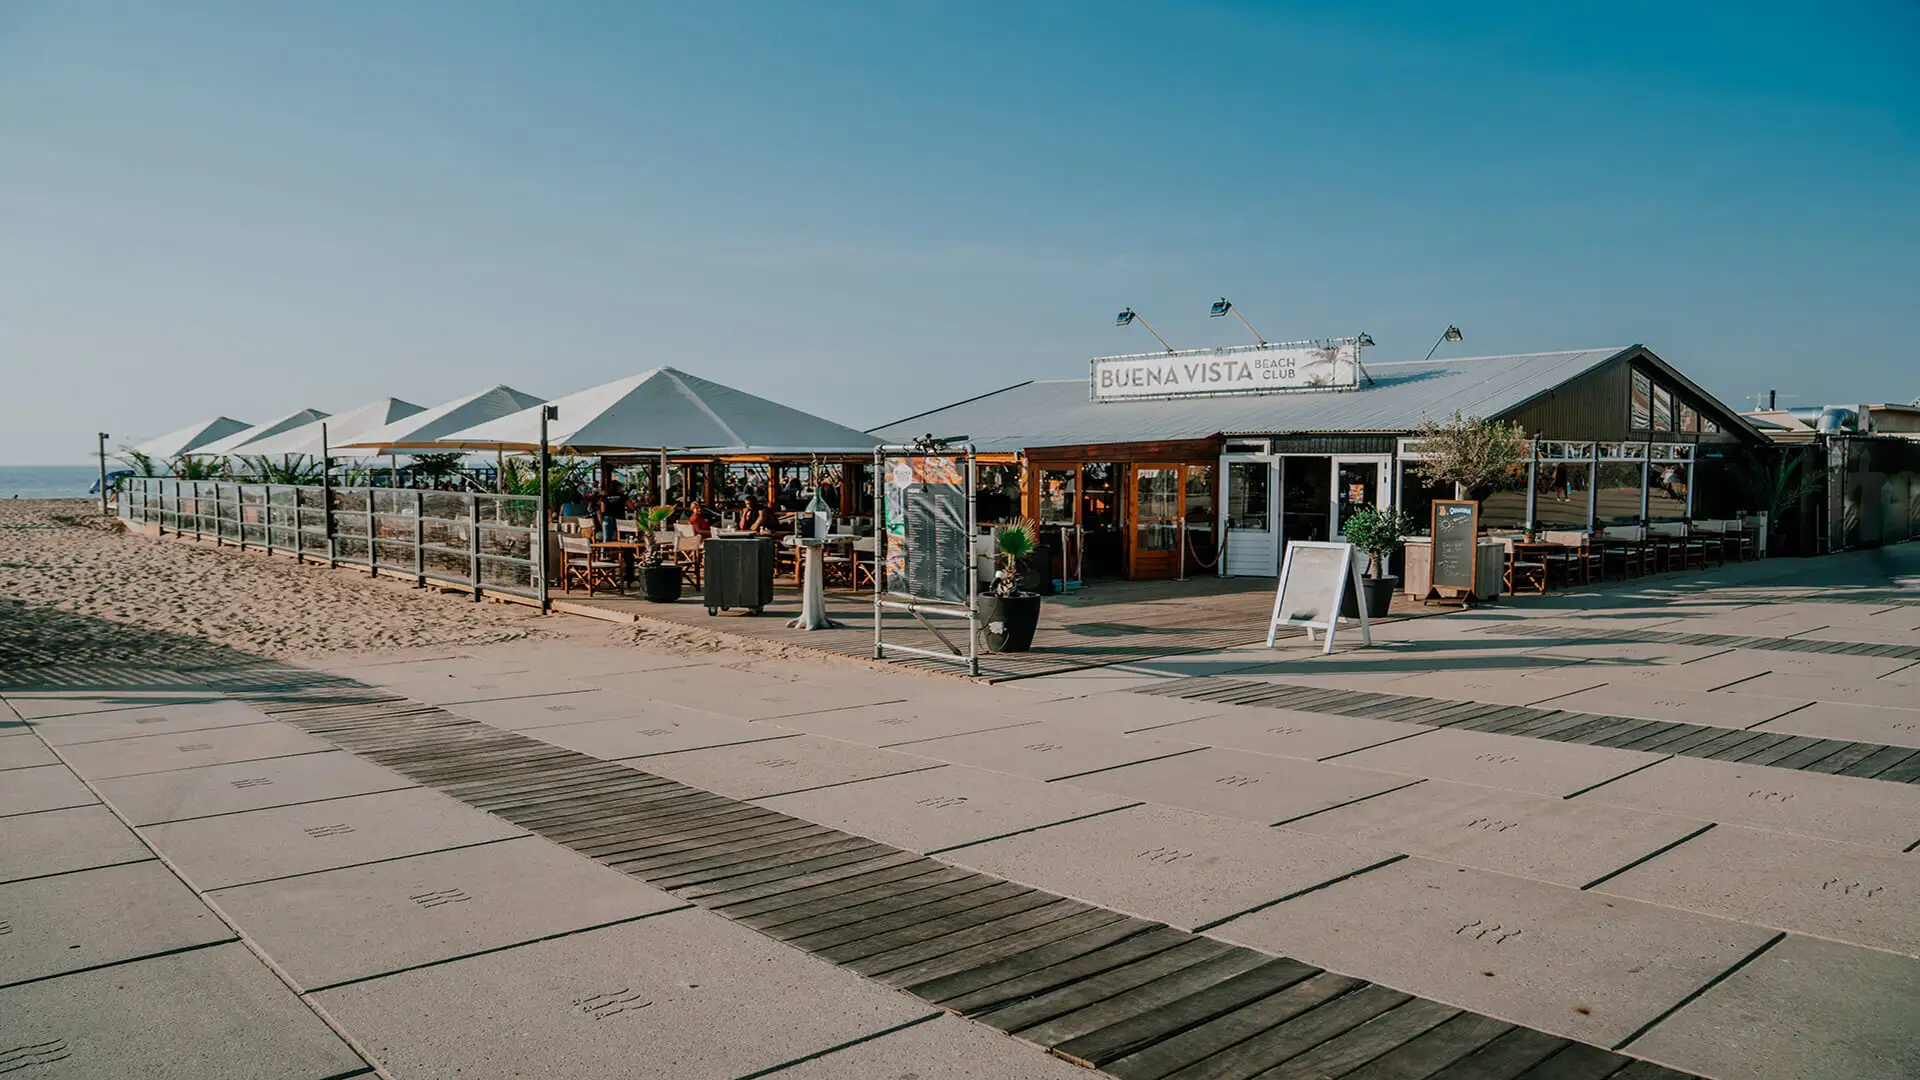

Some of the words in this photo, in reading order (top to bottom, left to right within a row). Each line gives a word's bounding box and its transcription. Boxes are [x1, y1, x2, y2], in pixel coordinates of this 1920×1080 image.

[1255, 357, 1295, 368] BEACH
[1101, 368, 1178, 388] BUENA
[1184, 361, 1253, 383] VISTA
[1263, 369, 1295, 380] CLUB
